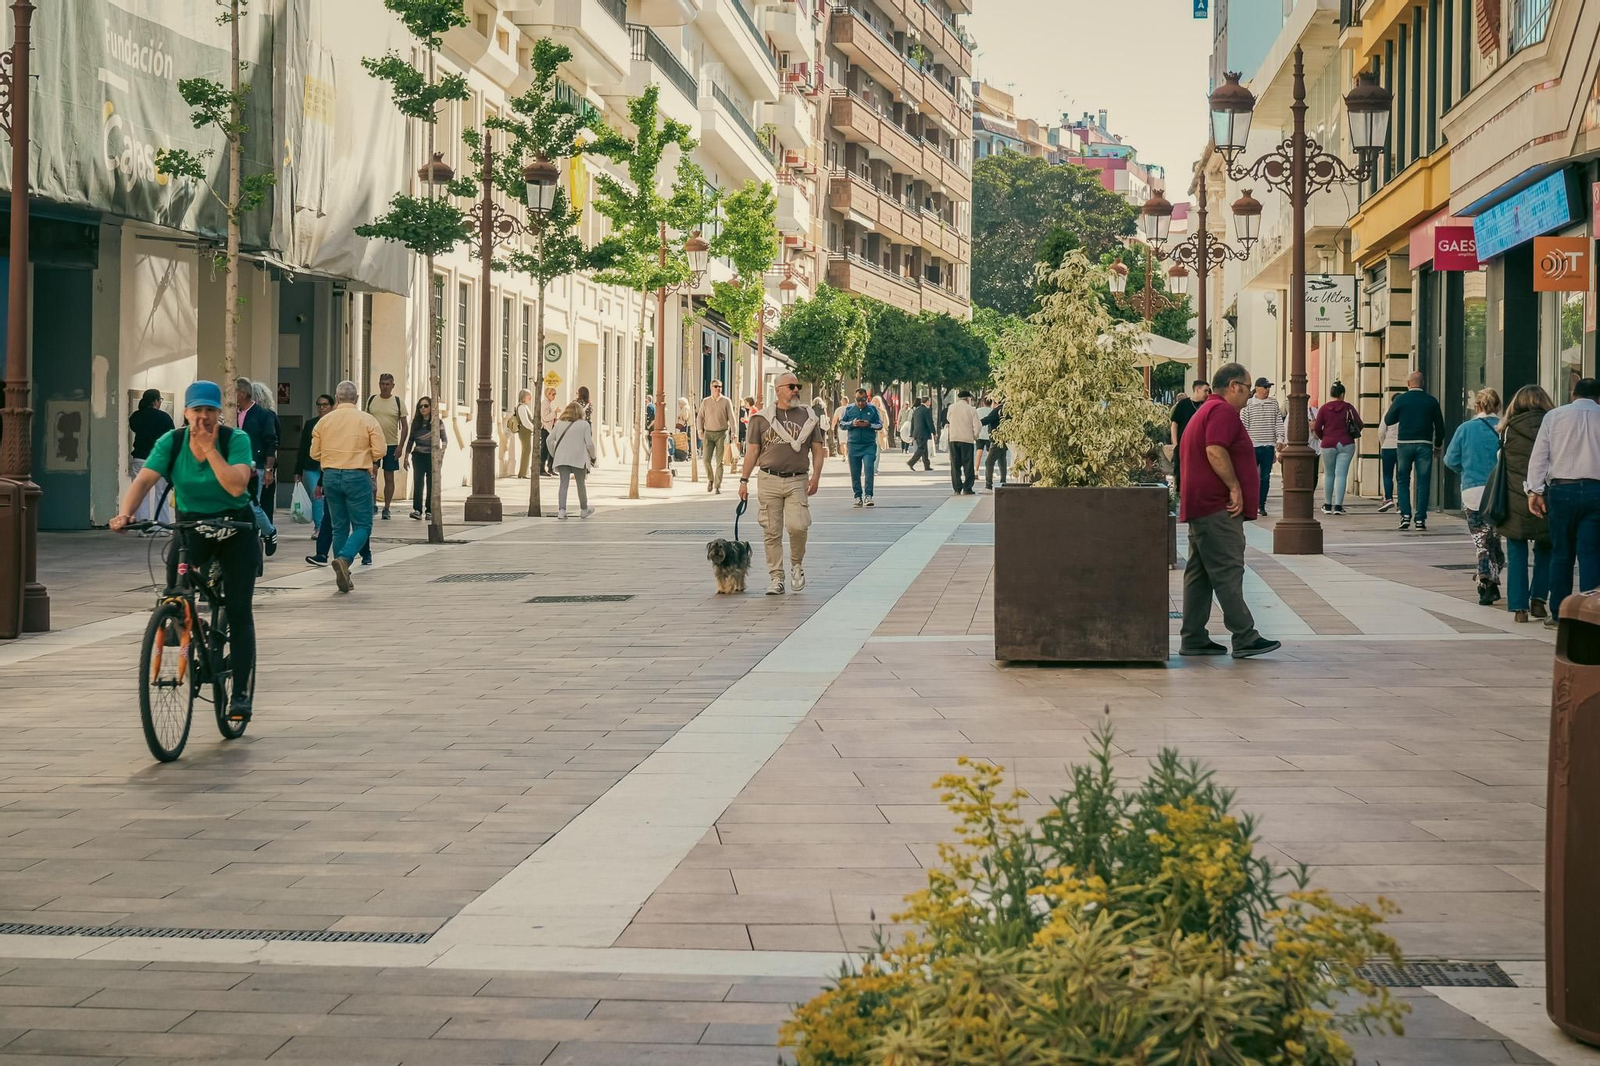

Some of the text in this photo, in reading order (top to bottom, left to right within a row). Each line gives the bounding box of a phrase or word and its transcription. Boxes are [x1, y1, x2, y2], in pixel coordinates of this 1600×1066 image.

[104, 18, 173, 80] Fundación
[1438, 239, 1476, 252] GAES
[1305, 290, 1352, 303] lus Ultra
